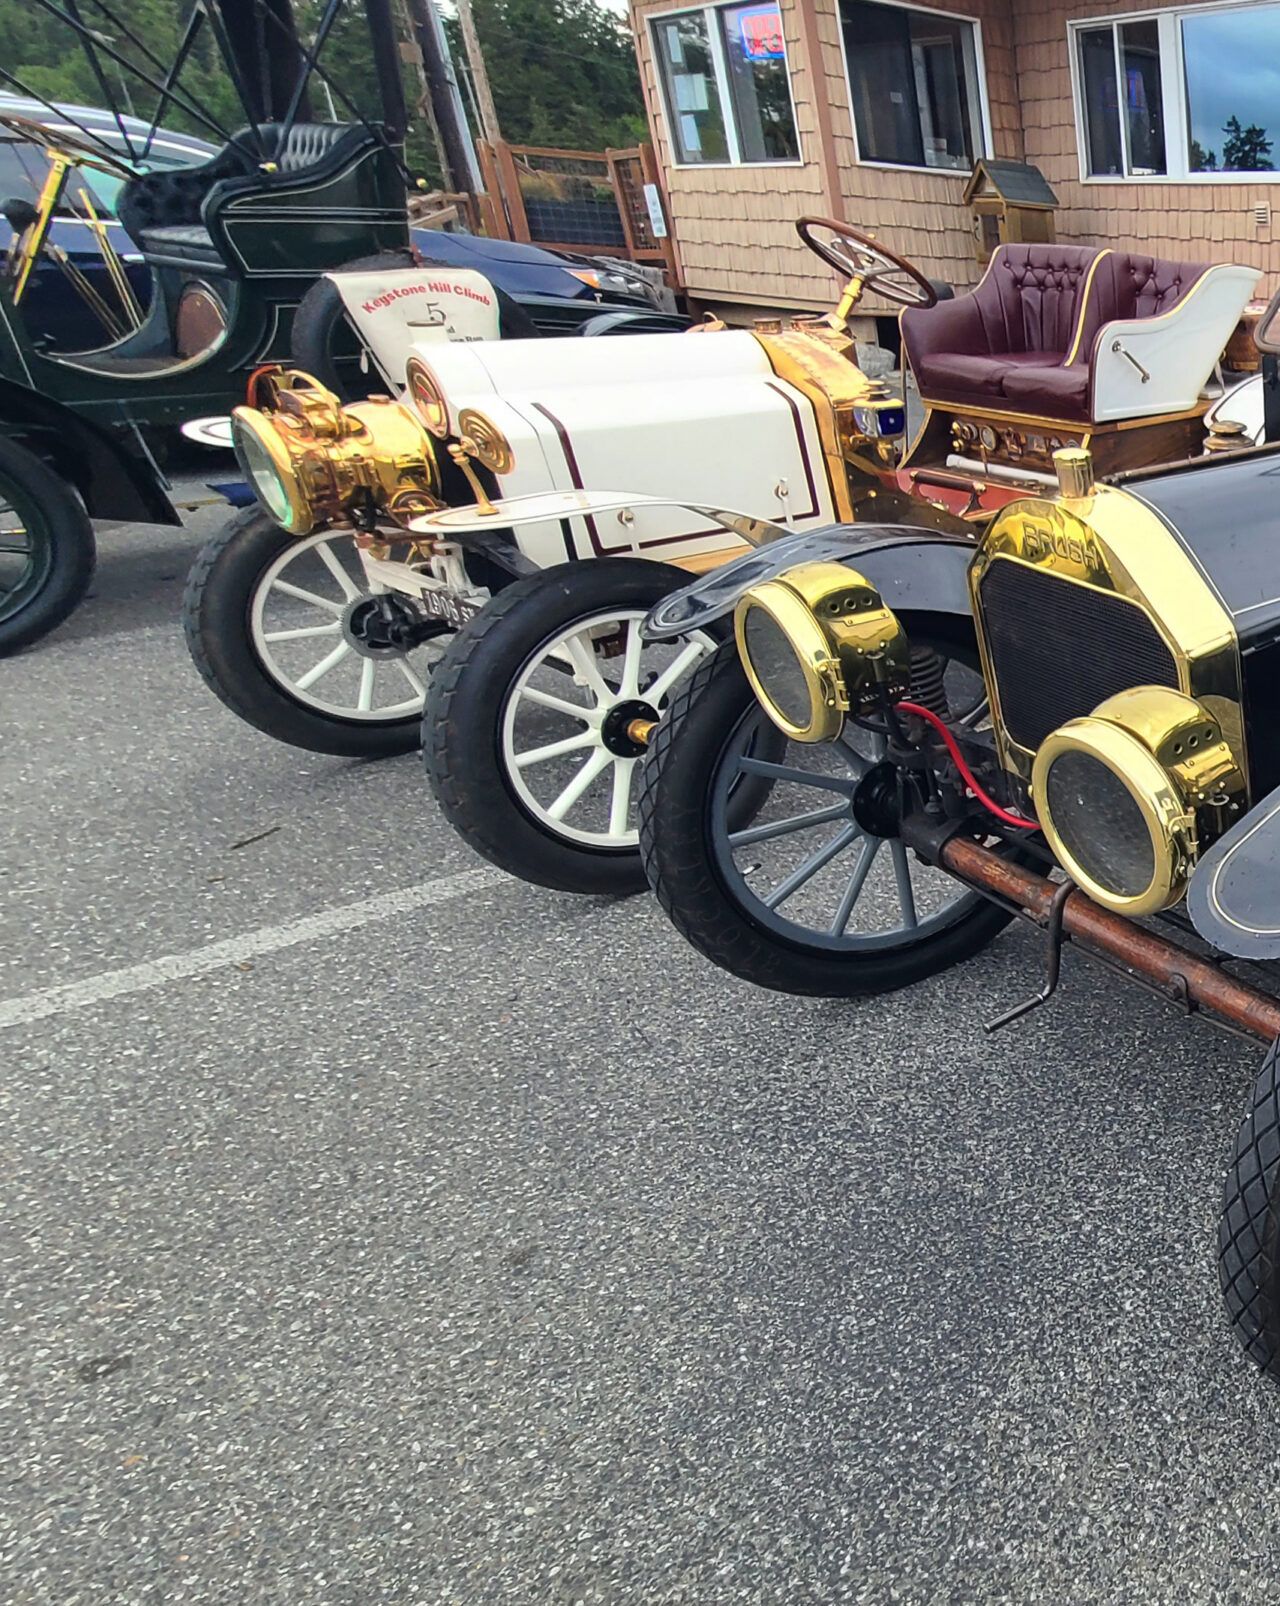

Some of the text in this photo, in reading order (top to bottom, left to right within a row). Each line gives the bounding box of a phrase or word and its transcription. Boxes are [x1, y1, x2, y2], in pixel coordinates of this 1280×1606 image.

[361, 282, 491, 314] Keystone Hill Climb
[1022, 520, 1099, 572] BRUSH
[425, 590, 460, 622] 1906
